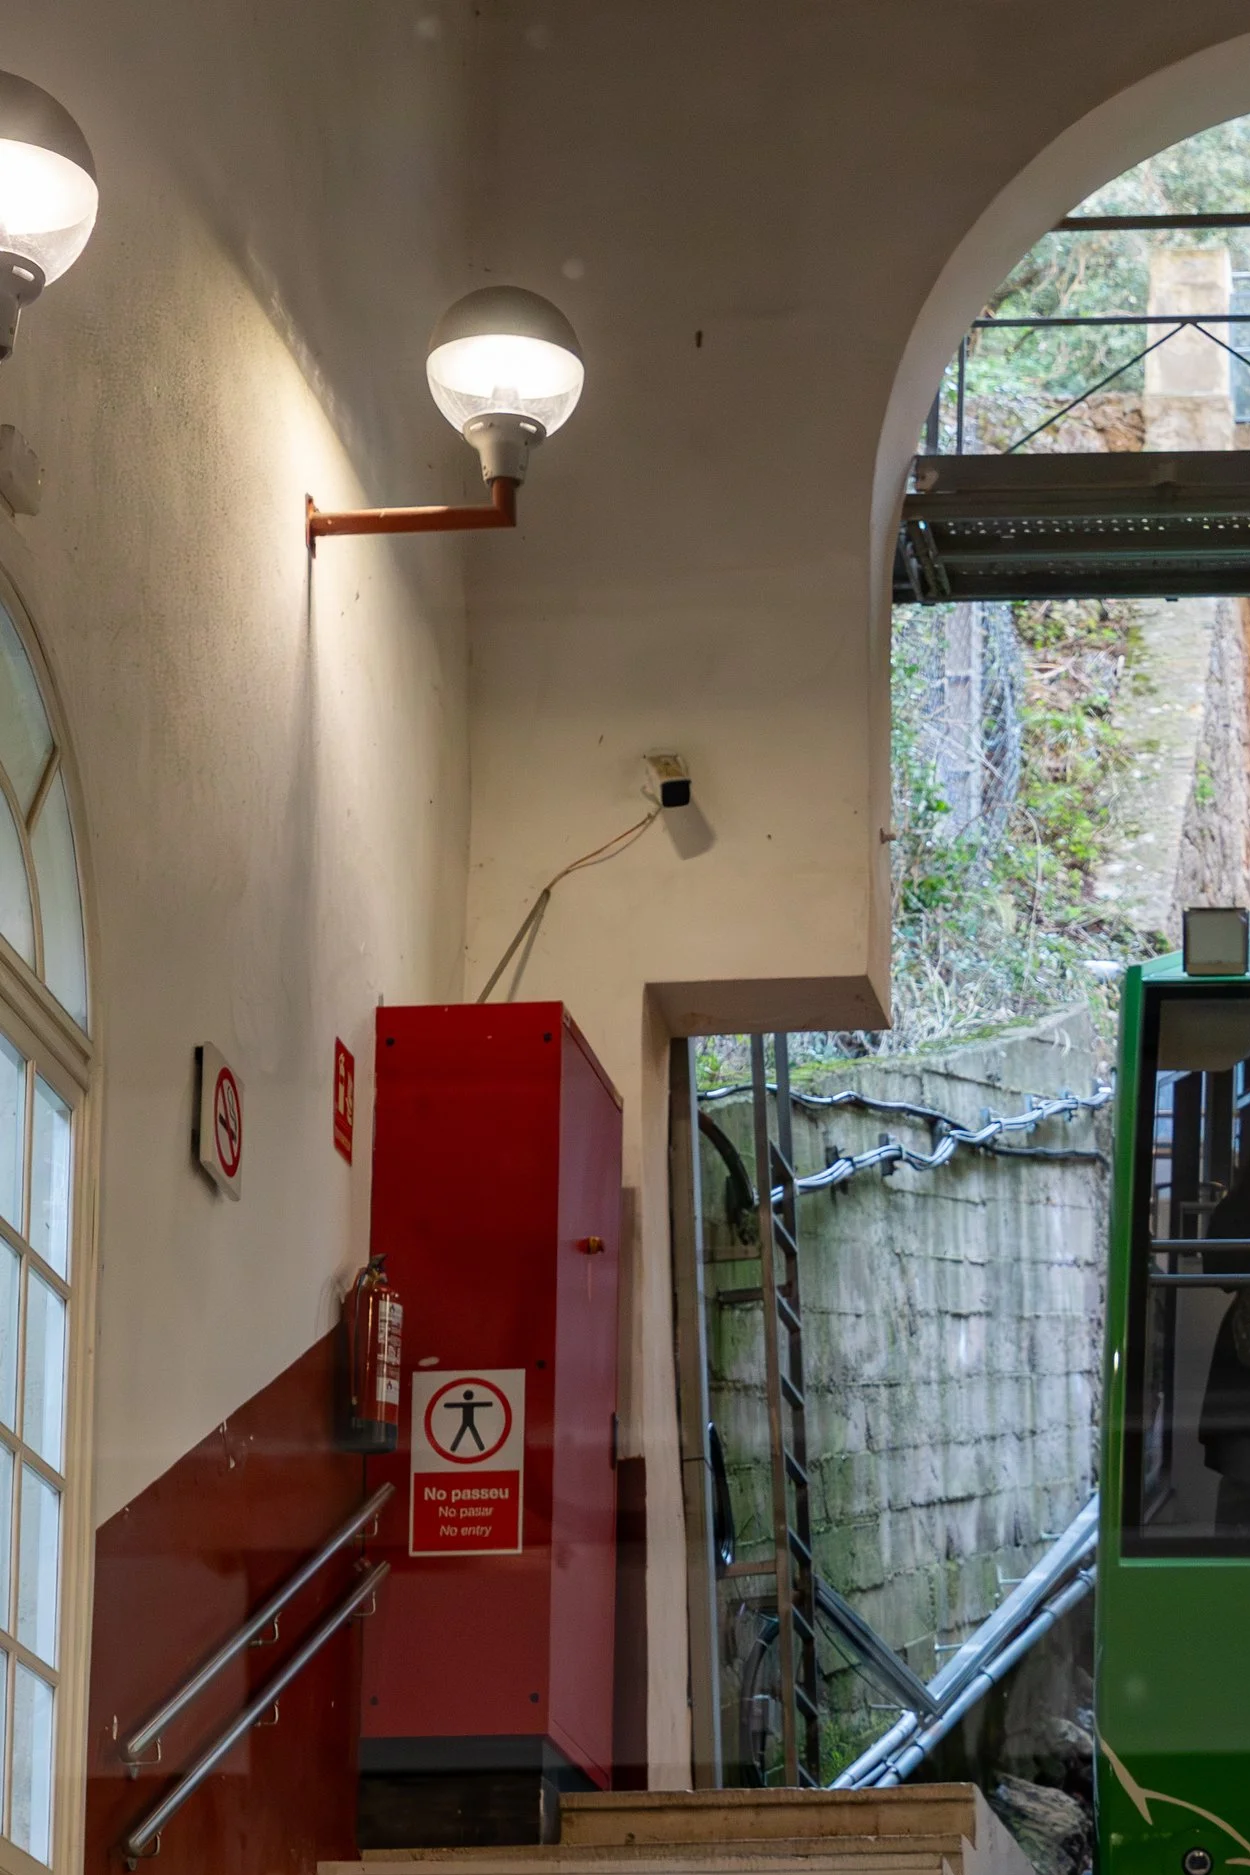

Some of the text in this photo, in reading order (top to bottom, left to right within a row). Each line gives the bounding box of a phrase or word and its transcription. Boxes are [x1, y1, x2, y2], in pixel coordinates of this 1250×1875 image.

[424, 1487, 510, 1503] No passeu
[438, 1506, 457, 1518] No
[439, 1525, 493, 1538] No entry
